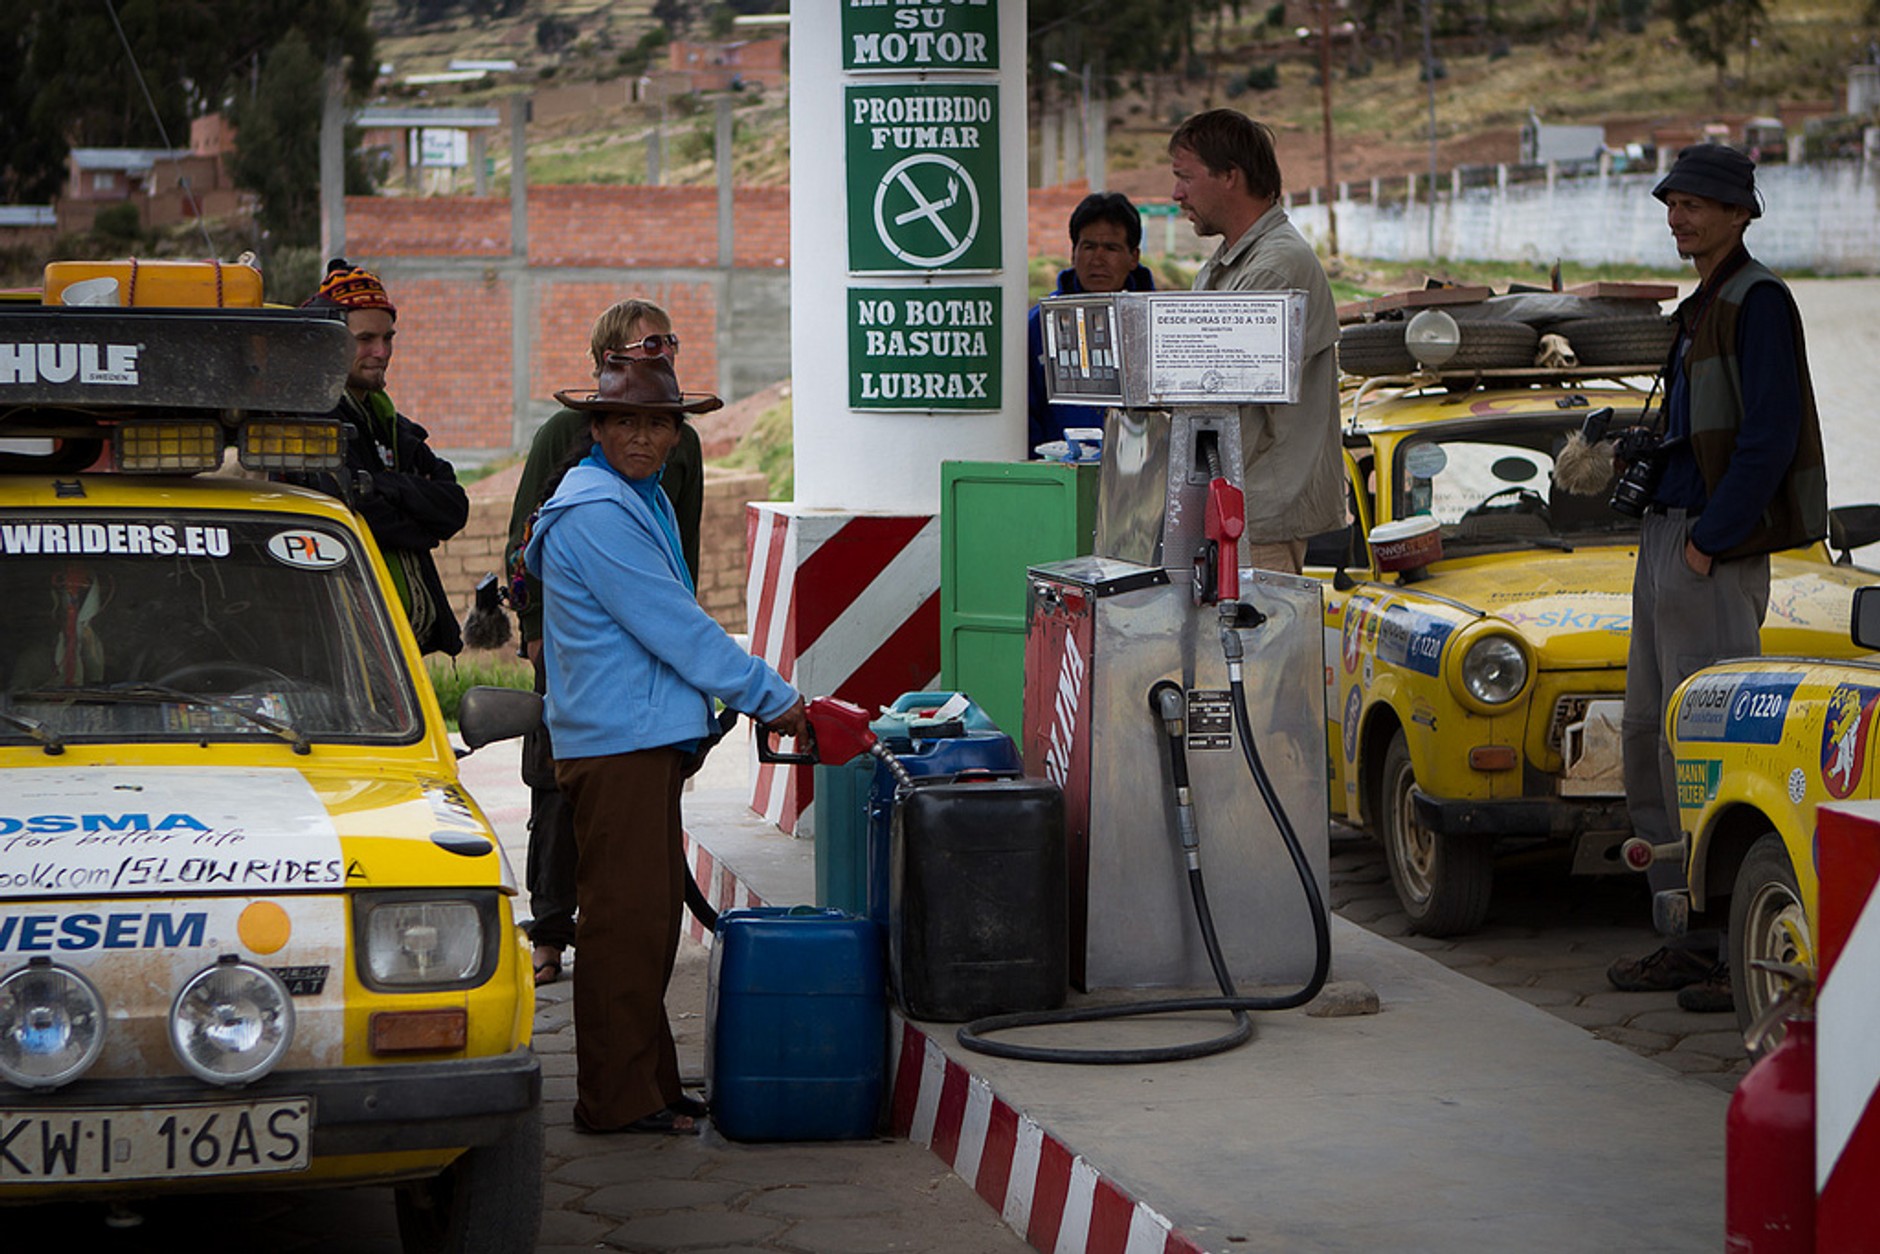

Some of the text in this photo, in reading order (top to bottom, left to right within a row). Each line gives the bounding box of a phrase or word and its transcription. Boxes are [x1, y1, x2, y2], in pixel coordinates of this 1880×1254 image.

[894, 8, 945, 29] SU
[853, 32, 988, 63] MOTOR
[853, 97, 991, 125] PROHIBIDO
[871, 127, 980, 150] FUMAR
[858, 300, 993, 326] NO BOTAR
[1157, 316, 1187, 325] DESDE
[1188, 316, 1220, 325] HORAS
[1246, 316, 1253, 325] A
[866, 330, 988, 357] BASURA
[89, 373, 129, 382] SWEDEN
[860, 372, 988, 399] LUBRAX
[0, 524, 231, 557] WRIDERS.EU
[283, 535, 337, 562] PL
[1421, 635, 1441, 659] 1220
[1683, 683, 1736, 720] global
[1750, 693, 1783, 718] 1220
[1677, 763, 1706, 783] MANN
[1678, 785, 1706, 805] FILTER
[4, 828, 247, 852] for better life
[277, 968, 326, 979] OLSKI
[0, 1108, 301, 1176] KWI 16AS
